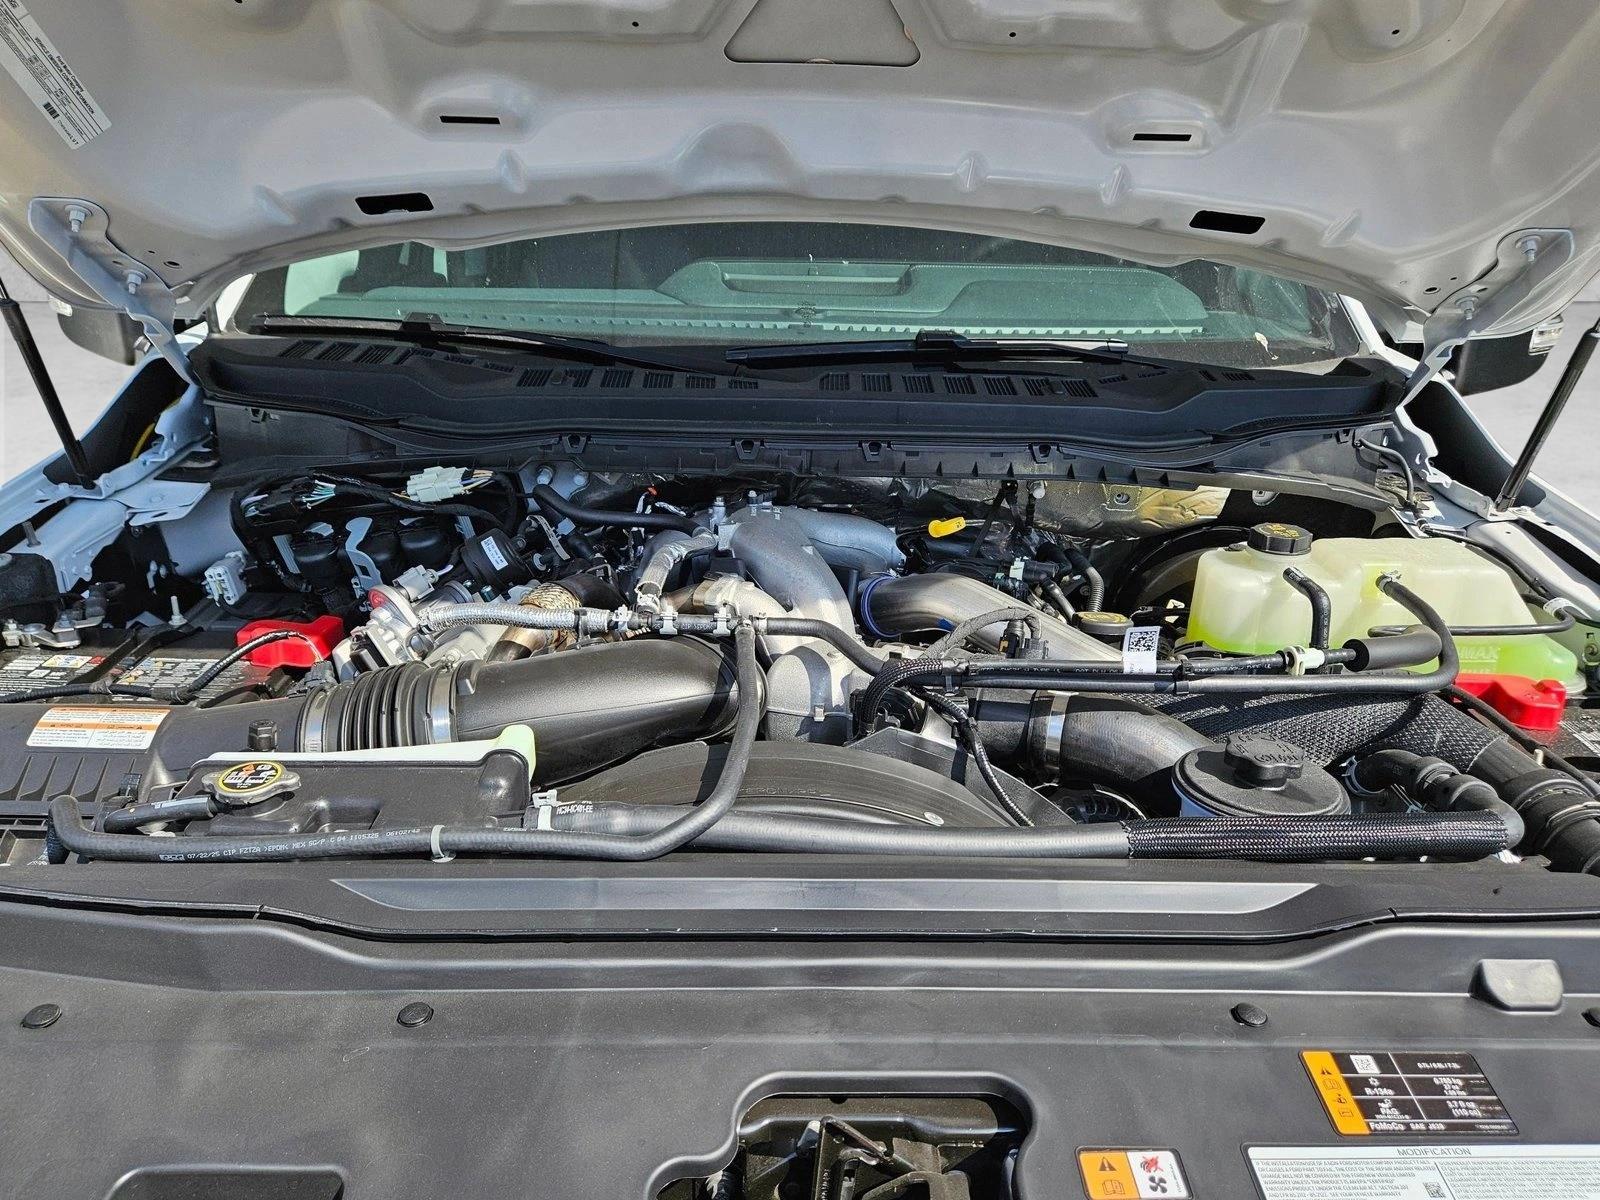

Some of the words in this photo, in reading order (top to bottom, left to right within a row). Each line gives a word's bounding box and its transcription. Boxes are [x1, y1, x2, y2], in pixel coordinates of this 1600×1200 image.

[1364, 1087, 1396, 1096] R-134a
[1380, 1108, 1400, 1116] PAG
[1369, 1122, 1406, 1131] FoMoCo
[1397, 1148, 1472, 1157] MODIFICATION
